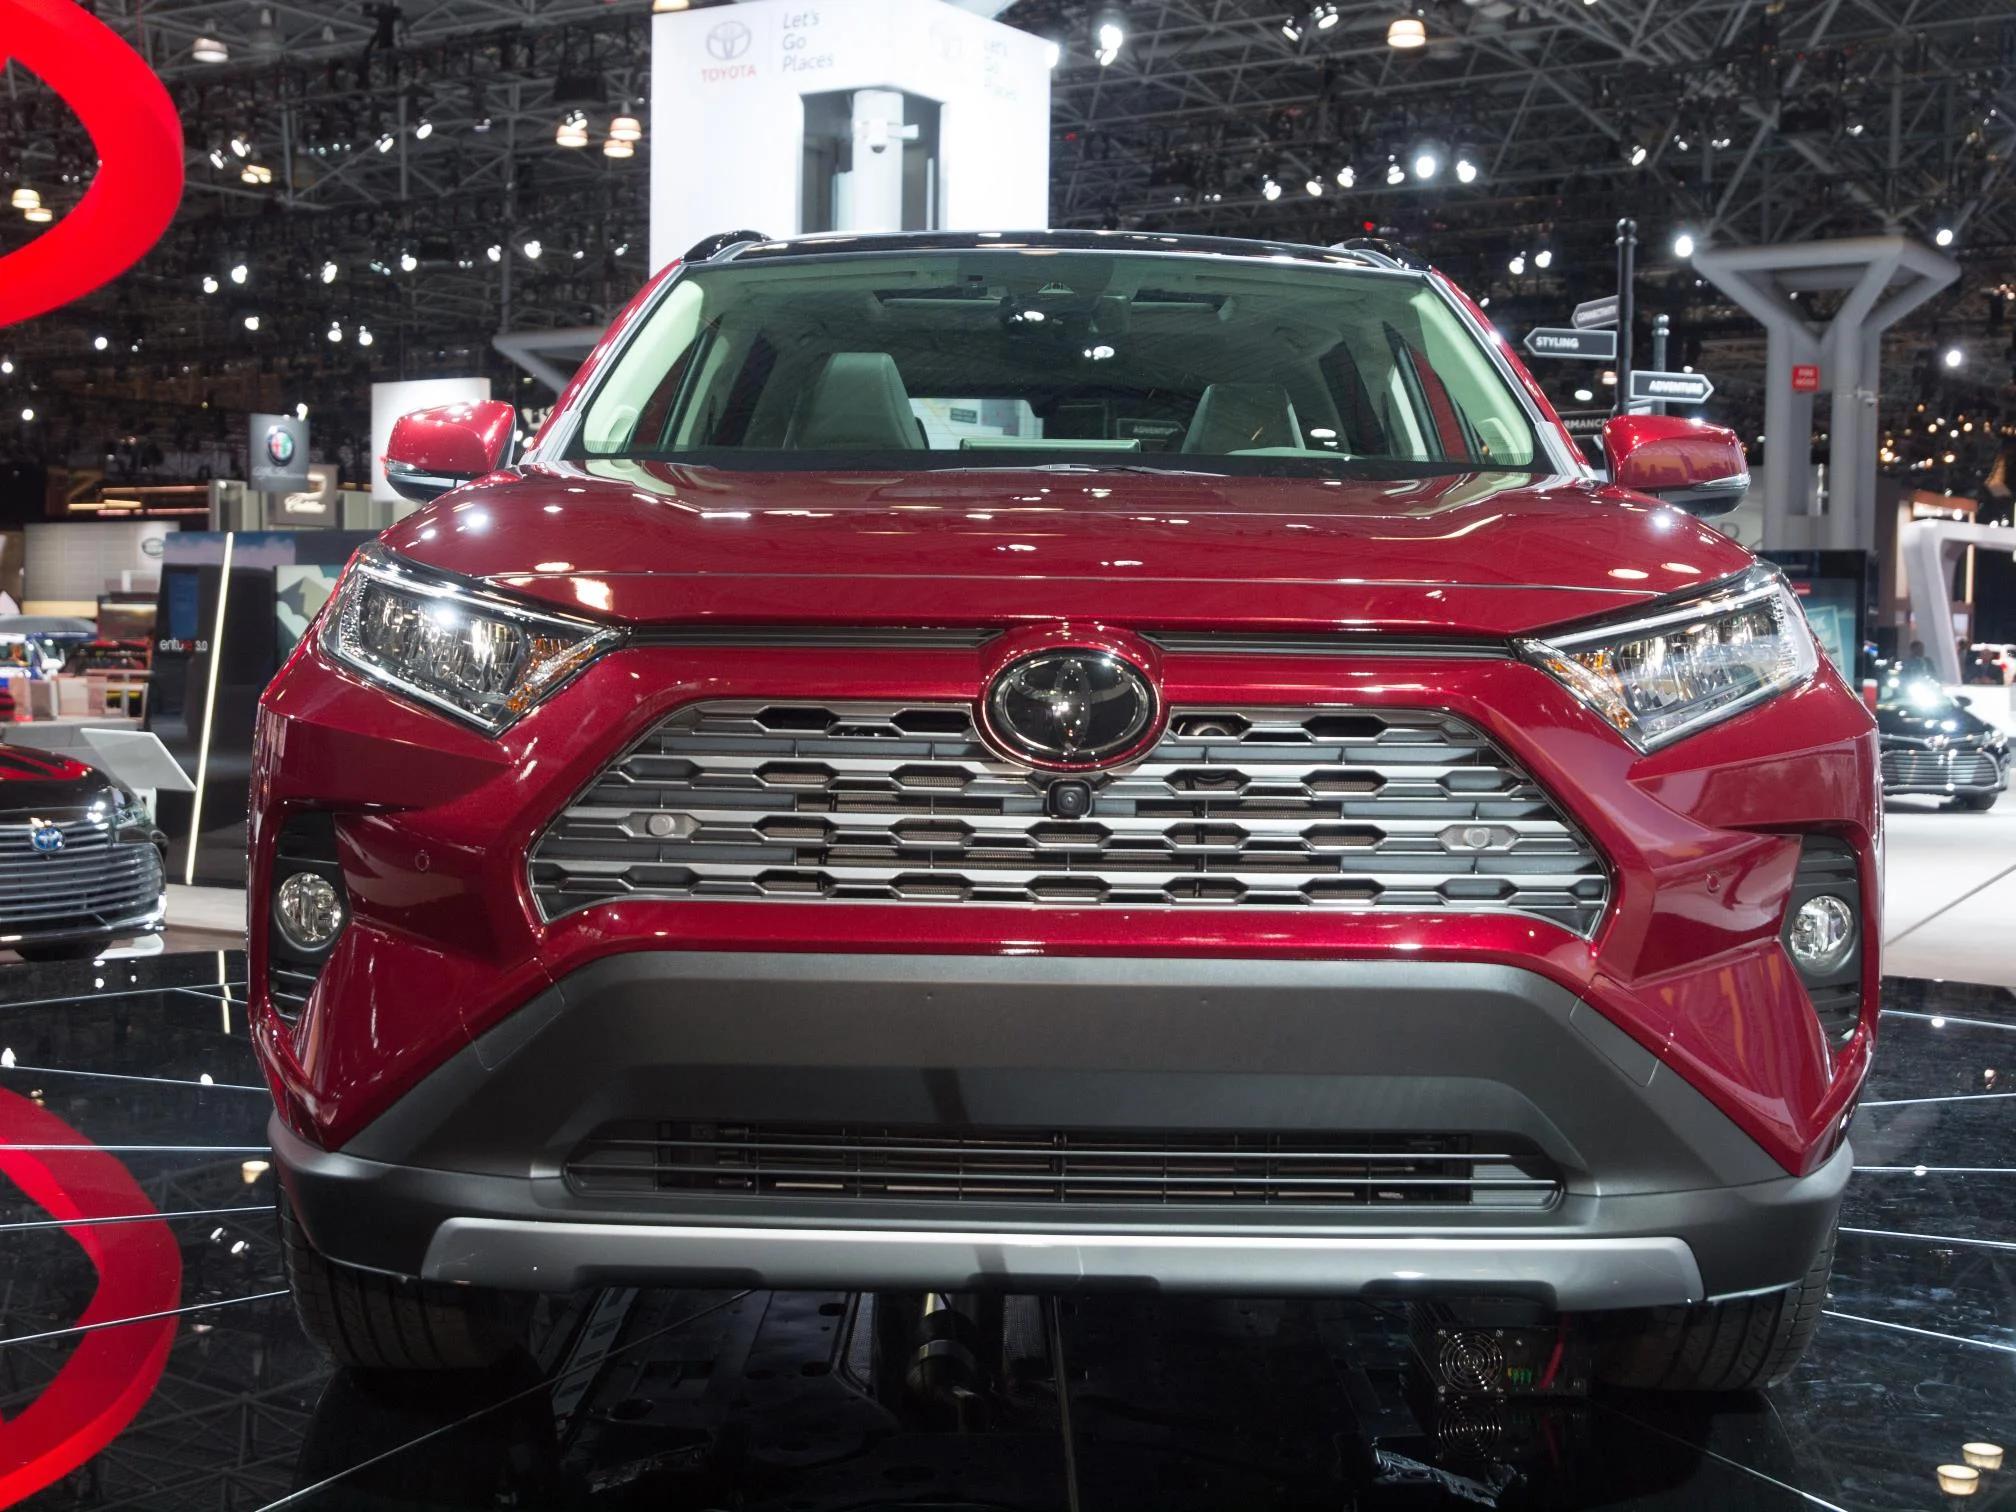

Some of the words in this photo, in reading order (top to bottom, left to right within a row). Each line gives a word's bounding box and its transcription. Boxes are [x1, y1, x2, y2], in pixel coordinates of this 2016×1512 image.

[783, 10, 820, 29] Let's
[782, 33, 807, 51] Go
[782, 53, 834, 73] Places
[701, 64, 757, 83] TOYOTA
[1536, 336, 1579, 349] STYLING
[1649, 380, 1704, 395] ADVENTURE
[195, 640, 208, 651] 3.0
